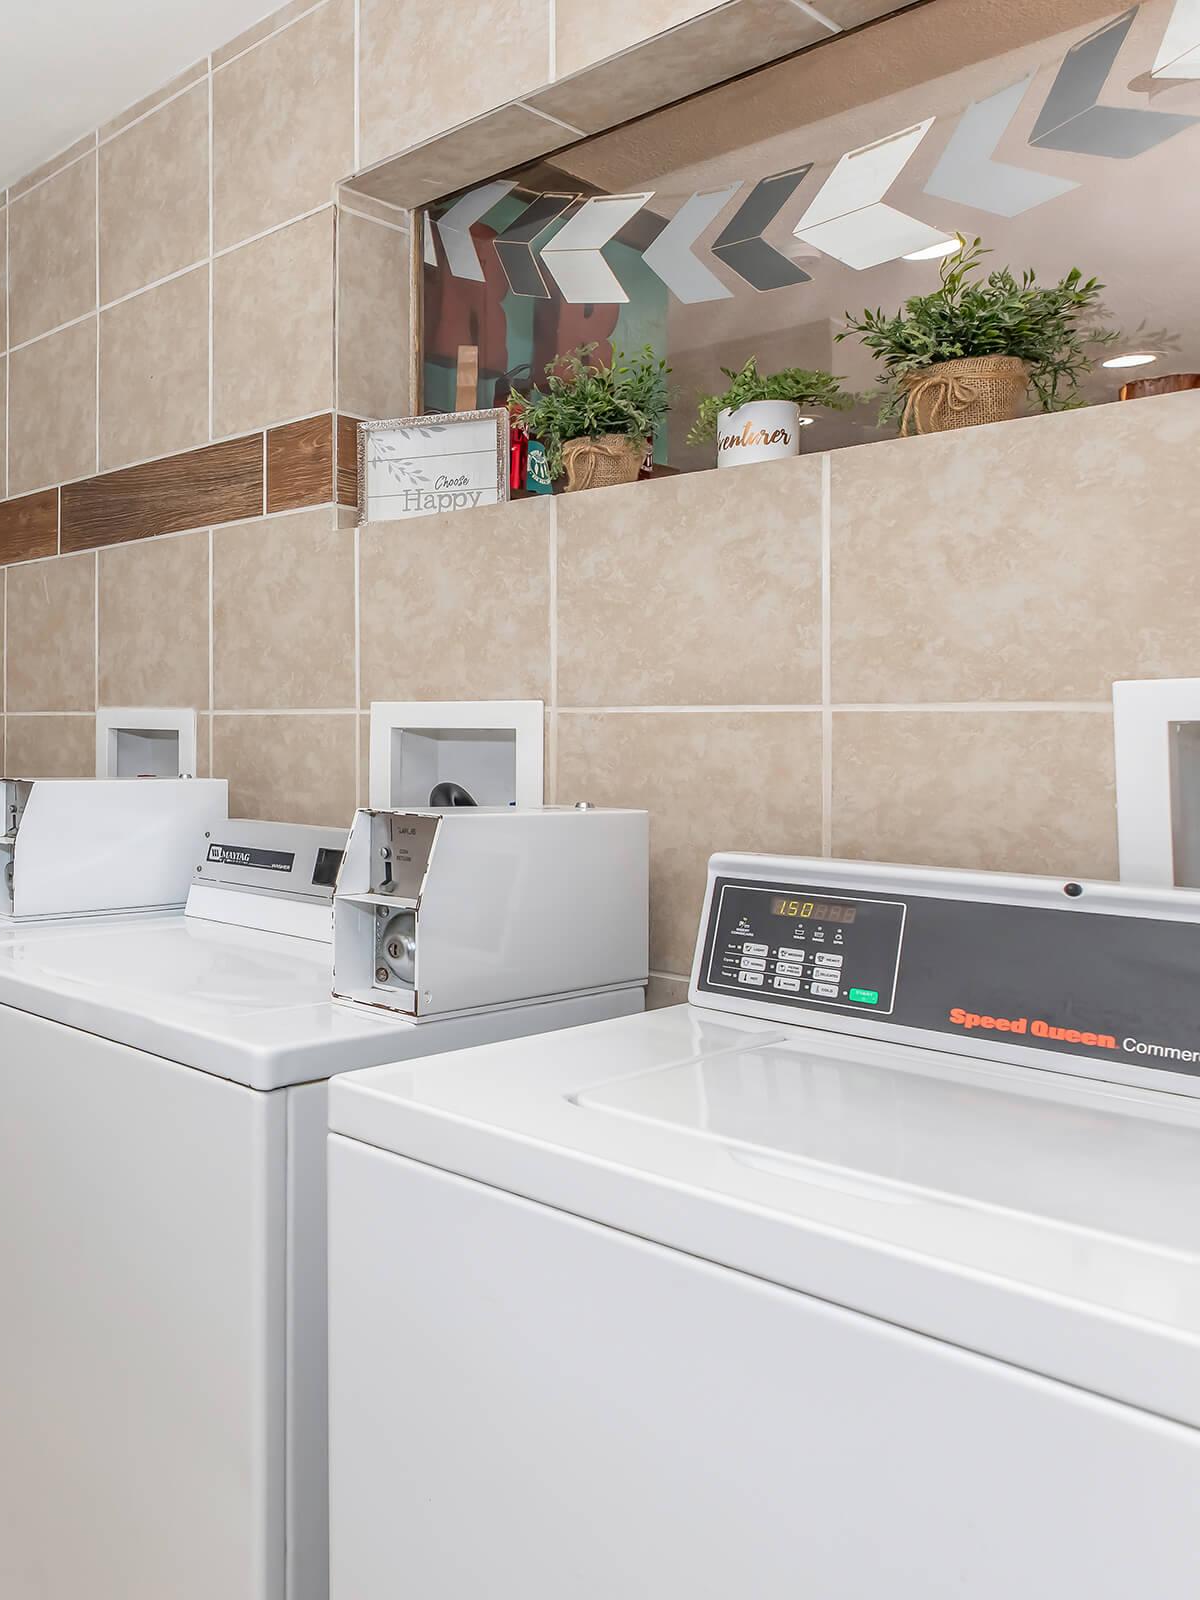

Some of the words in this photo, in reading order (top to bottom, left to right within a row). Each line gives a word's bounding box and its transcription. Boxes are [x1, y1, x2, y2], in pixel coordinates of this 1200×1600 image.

[435, 475, 469, 490] Choose
[402, 488, 483, 513] Happy
[220, 848, 250, 862] MAYTAG
[949, 1008, 1028, 1035] Speed
[1030, 1020, 1118, 1049] Queen
[1123, 1038, 1200, 1062] Commer
